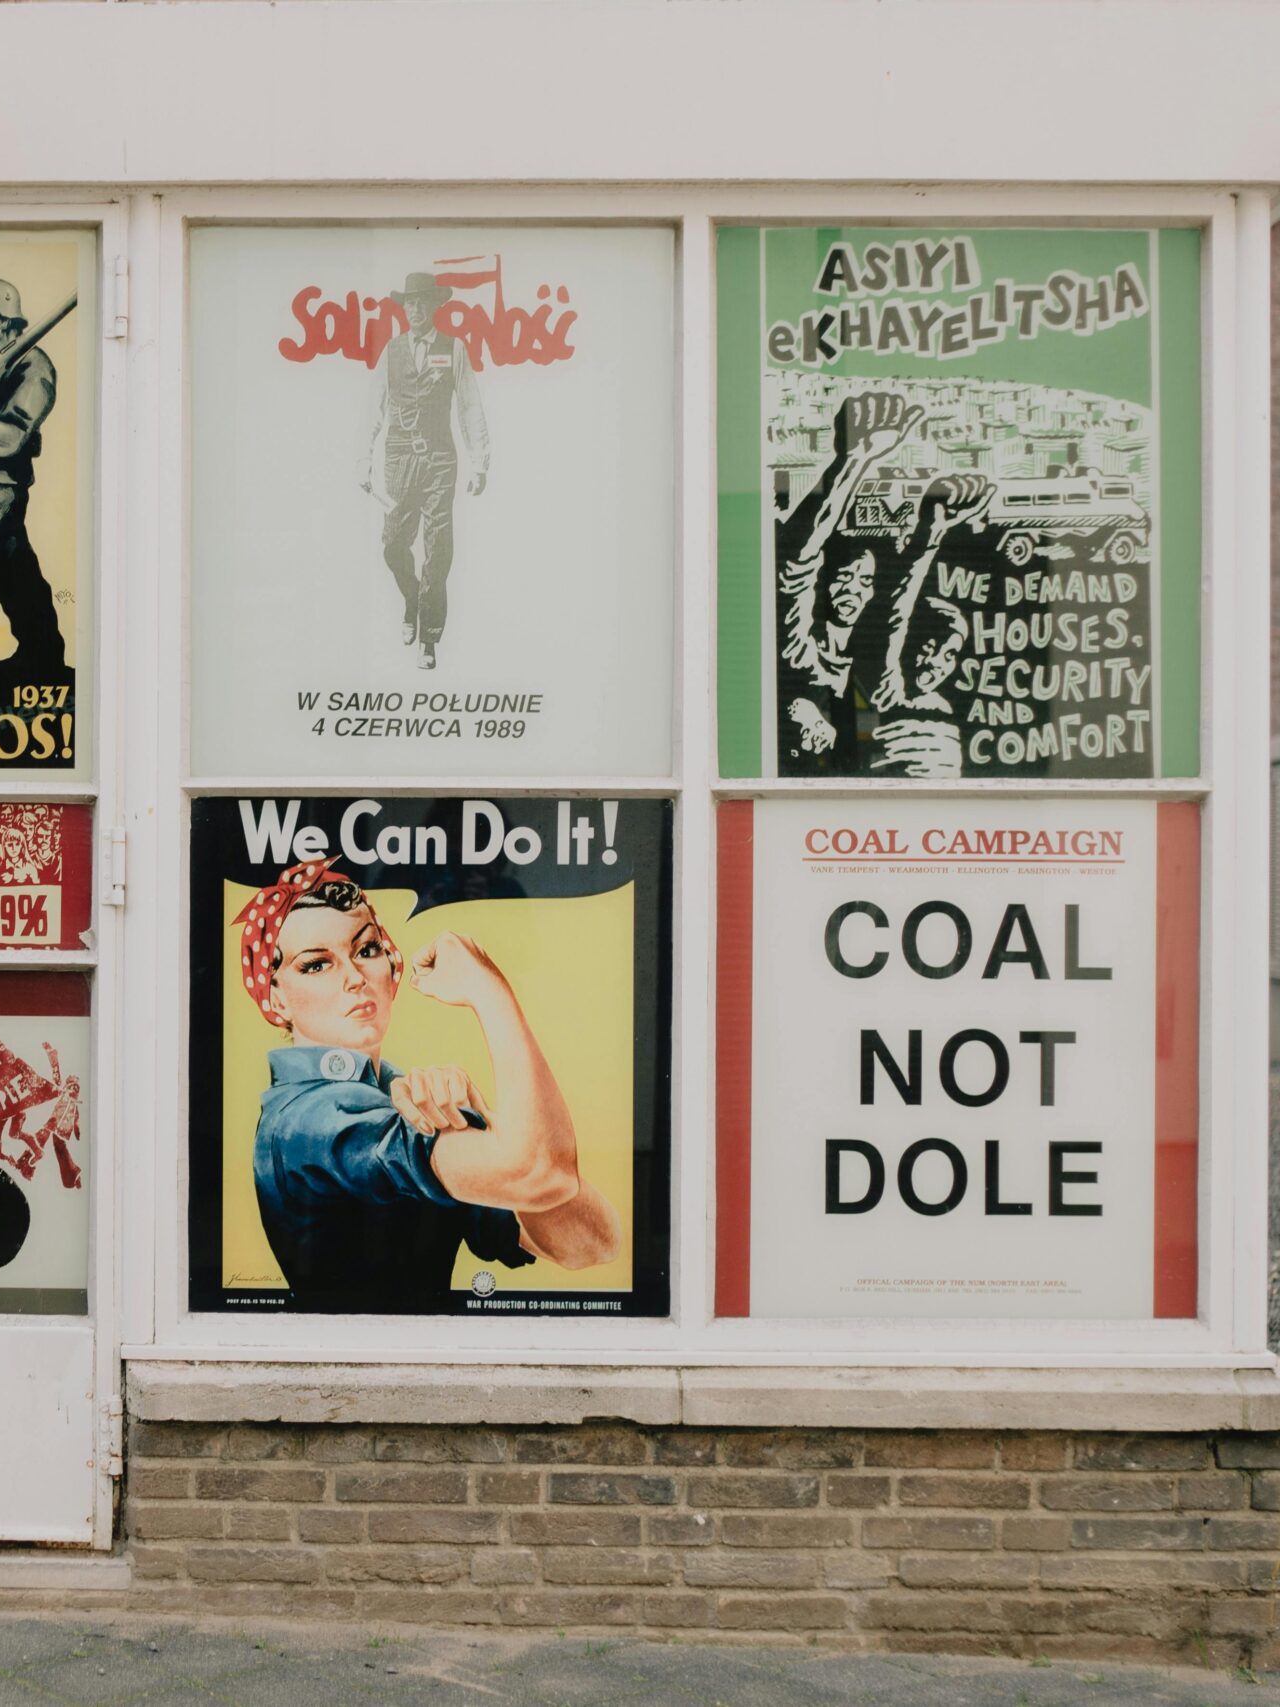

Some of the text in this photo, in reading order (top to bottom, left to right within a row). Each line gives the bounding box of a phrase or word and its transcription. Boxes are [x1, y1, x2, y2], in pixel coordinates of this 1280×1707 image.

[817, 241, 972, 292] ASIYI
[938, 562, 1137, 606] WE DEMAND
[13, 685, 70, 709] 1937
[297, 692, 544, 713] W SAMO POŁUDNIE
[955, 656, 1151, 705] SECURITY
[312, 717, 526, 738] 4 CZERWCA 1989
[968, 699, 1034, 726] AND
[969, 710, 1150, 765] COMFORT
[238, 800, 329, 865] We
[340, 800, 447, 865] Can
[462, 801, 541, 865] Do
[805, 829, 1124, 855] COAL CAMPAIGN
[824, 900, 1113, 980] COAL
[860, 1028, 1077, 1107] NOT
[825, 1137, 1103, 1216] DOLE
[467, 1300, 621, 1310] WAR PRODUCTION CO-ORDINATING COMMITTEE
